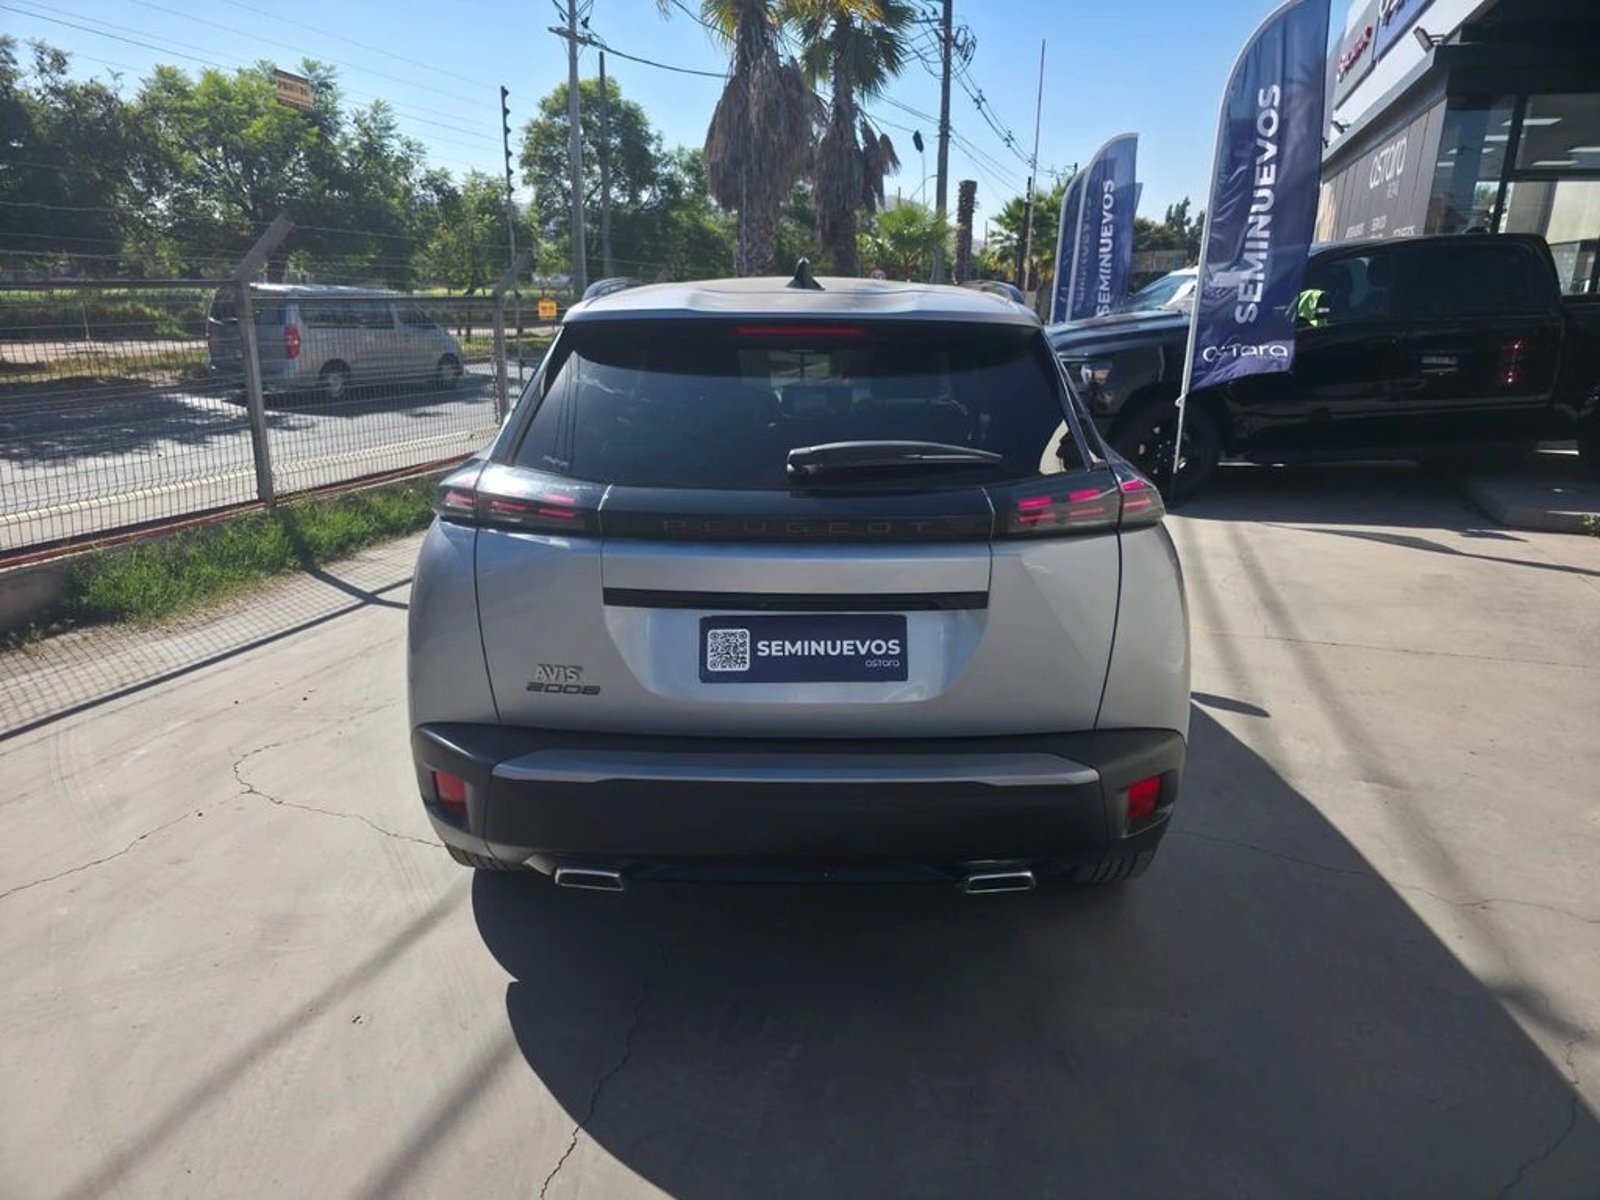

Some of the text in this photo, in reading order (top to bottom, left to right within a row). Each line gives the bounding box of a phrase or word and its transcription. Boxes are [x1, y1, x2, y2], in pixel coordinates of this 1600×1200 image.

[1235, 84, 1281, 324] SEMINUEVOS
[1096, 179, 1115, 318] SEMINUEVOS
[756, 639, 901, 657] SEMINUEVOS
[865, 659, 901, 668] astara
[535, 664, 583, 683] AVIS
